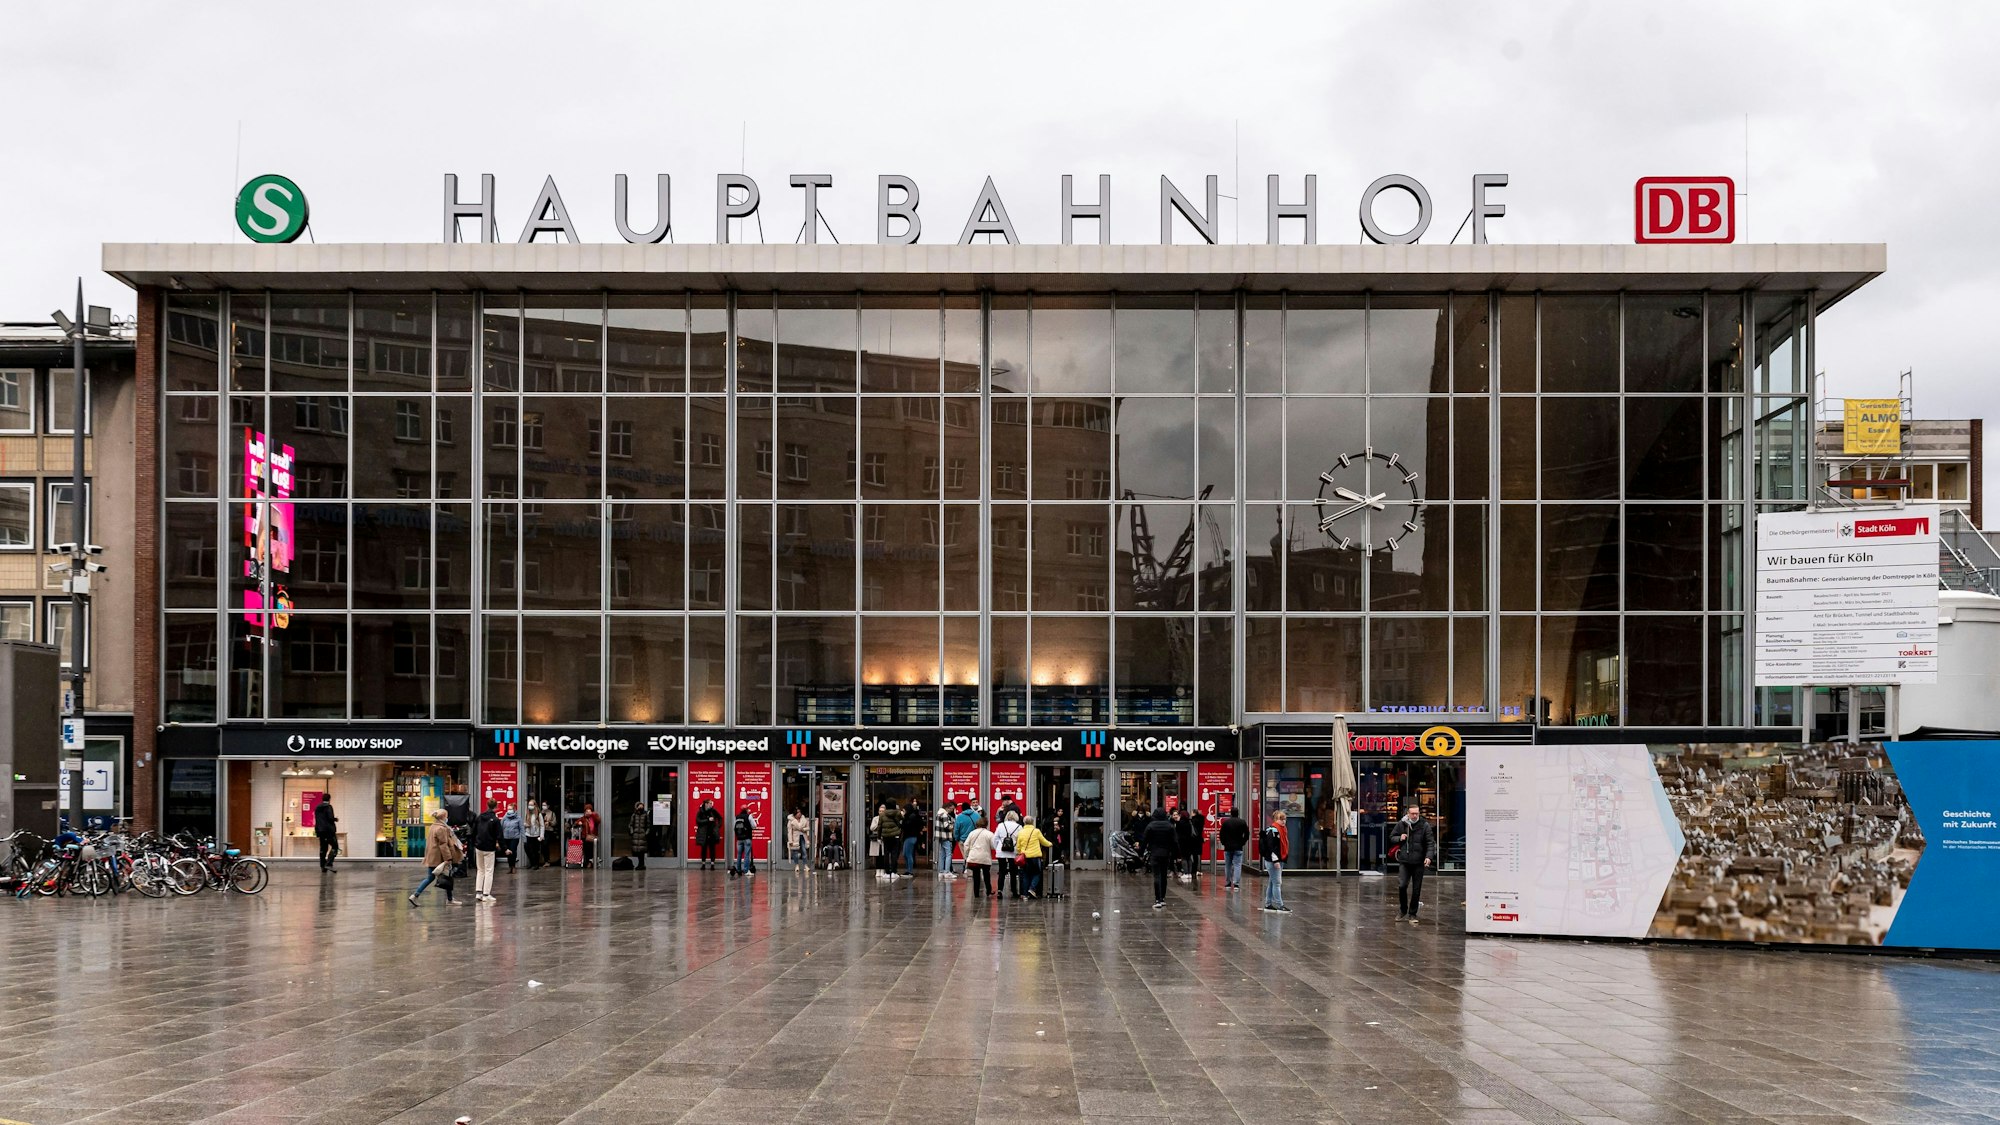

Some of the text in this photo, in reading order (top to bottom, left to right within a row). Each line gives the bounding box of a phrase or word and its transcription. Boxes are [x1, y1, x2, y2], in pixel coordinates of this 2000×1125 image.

[247, 182, 293, 236] S
[443, 173, 1509, 244] HAUPTBAHNHOF
[1648, 187, 1722, 234] DB
[1860, 413, 1898, 422] ALMO
[1779, 528, 1836, 536] Oberbürgermeisterin
[1857, 524, 1896, 534] Stadt Köln
[1767, 552, 1874, 566] Wir bauen für Köln
[1898, 644, 1932, 656] TORKRET
[308, 738, 402, 748] THE BODY SHOP
[526, 736, 629, 754] NetCologne
[678, 736, 768, 754] Highspeed
[819, 736, 921, 754] NetCologne
[972, 736, 1062, 754] Highspeed
[1114, 736, 1216, 755] NetCologne
[61, 778, 94, 786] Caio
[383, 780, 394, 805] REFILL
